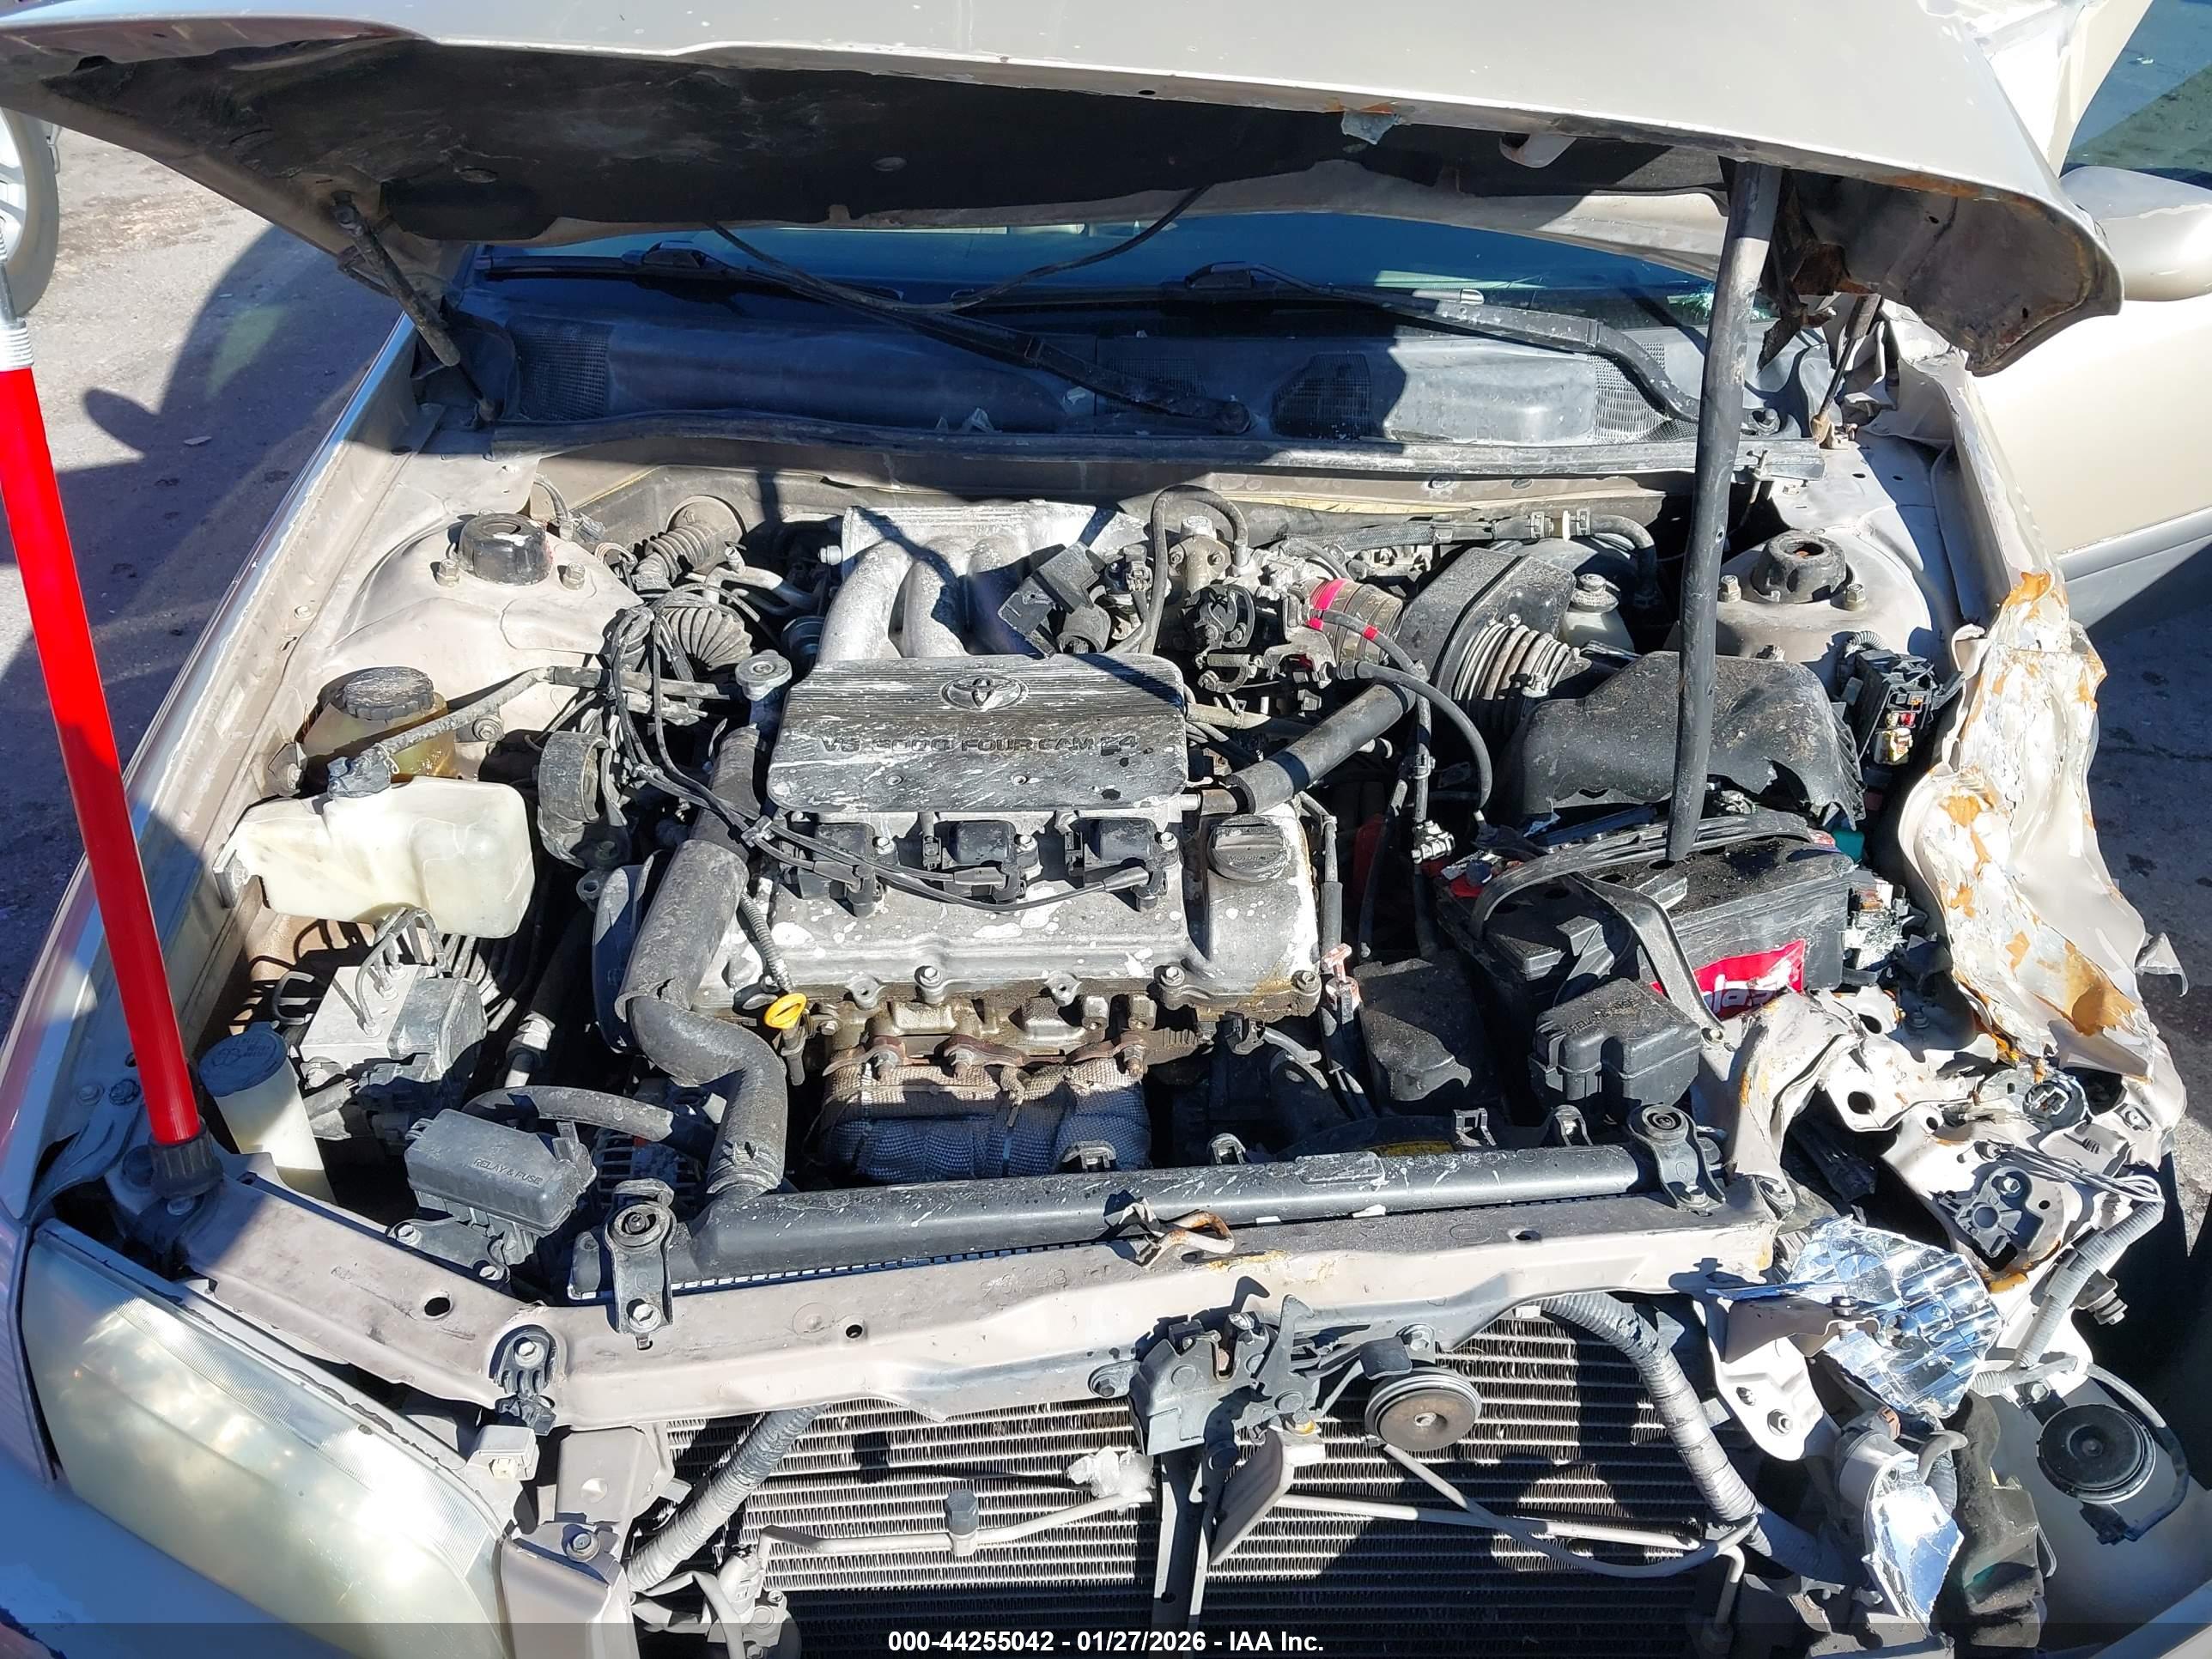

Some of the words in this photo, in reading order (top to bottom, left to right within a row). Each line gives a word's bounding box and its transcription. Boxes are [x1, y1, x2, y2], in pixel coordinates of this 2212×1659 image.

[820, 736, 860, 752] V6
[871, 738, 950, 751] 3000
[961, 738, 1032, 751] FOUR
[1039, 737, 1094, 751] CAM
[1100, 735, 1138, 752] 24
[474, 1158, 507, 1174] RELAY
[515, 1171, 544, 1186] FUSE
